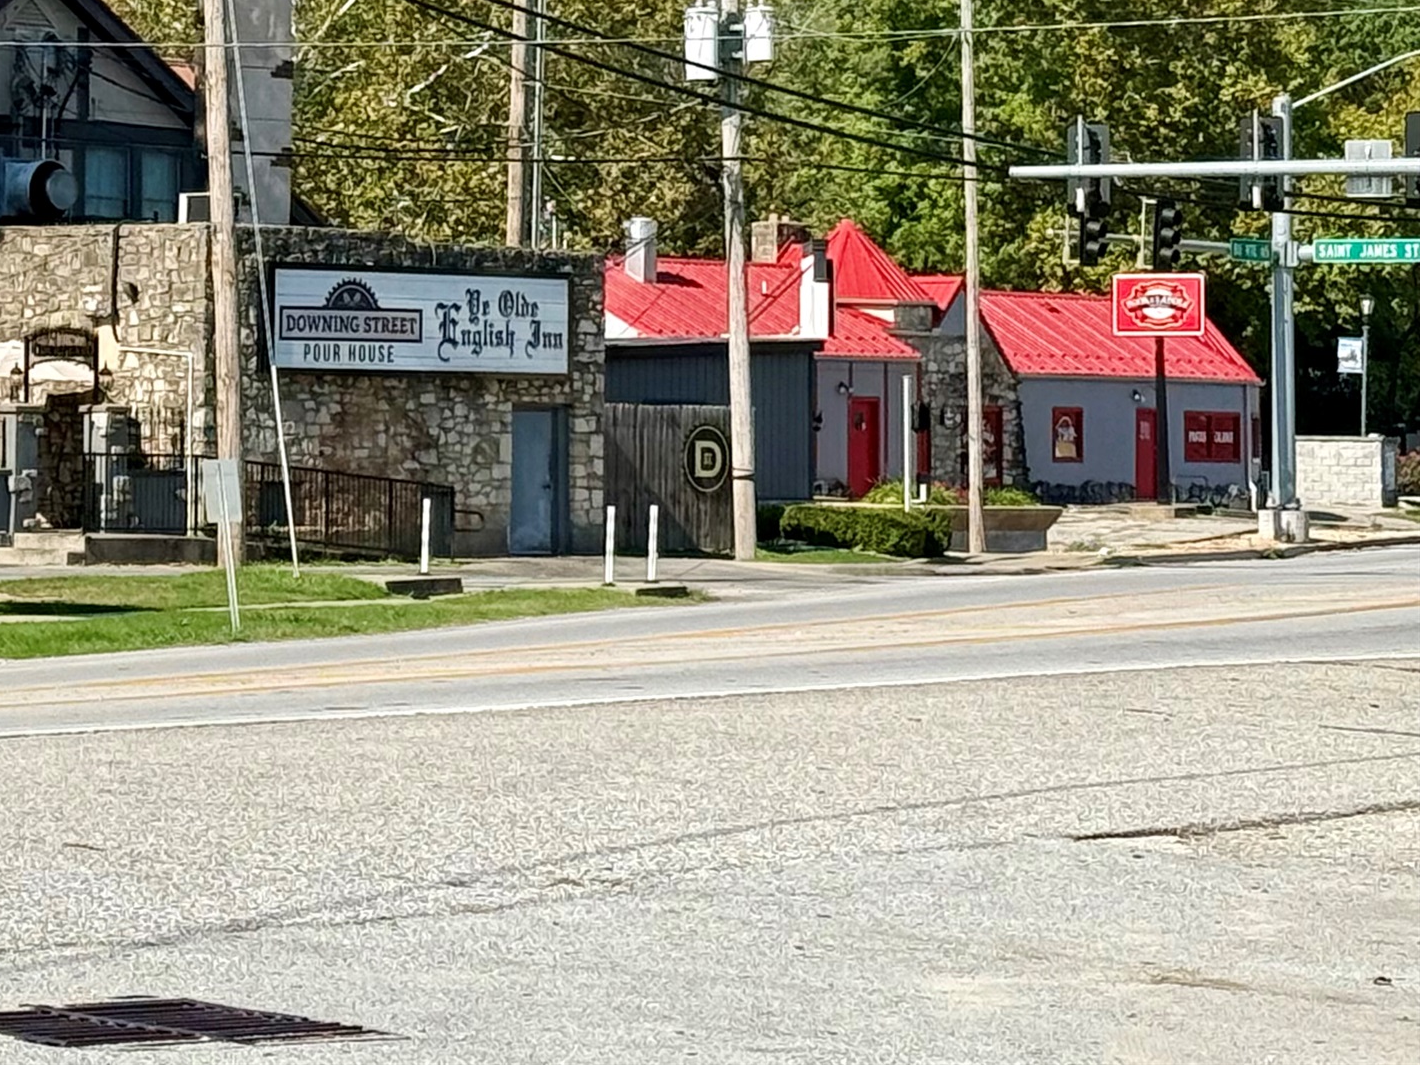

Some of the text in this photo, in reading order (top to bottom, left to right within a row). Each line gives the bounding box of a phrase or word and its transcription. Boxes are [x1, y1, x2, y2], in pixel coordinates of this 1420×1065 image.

[1318, 244, 1420, 258] SAINT JAMES ST
[498, 289, 539, 318] Olde
[285, 314, 417, 336] DOWNING STREET
[434, 302, 563, 362] English Inn
[303, 343, 395, 363] POUR HOUSE
